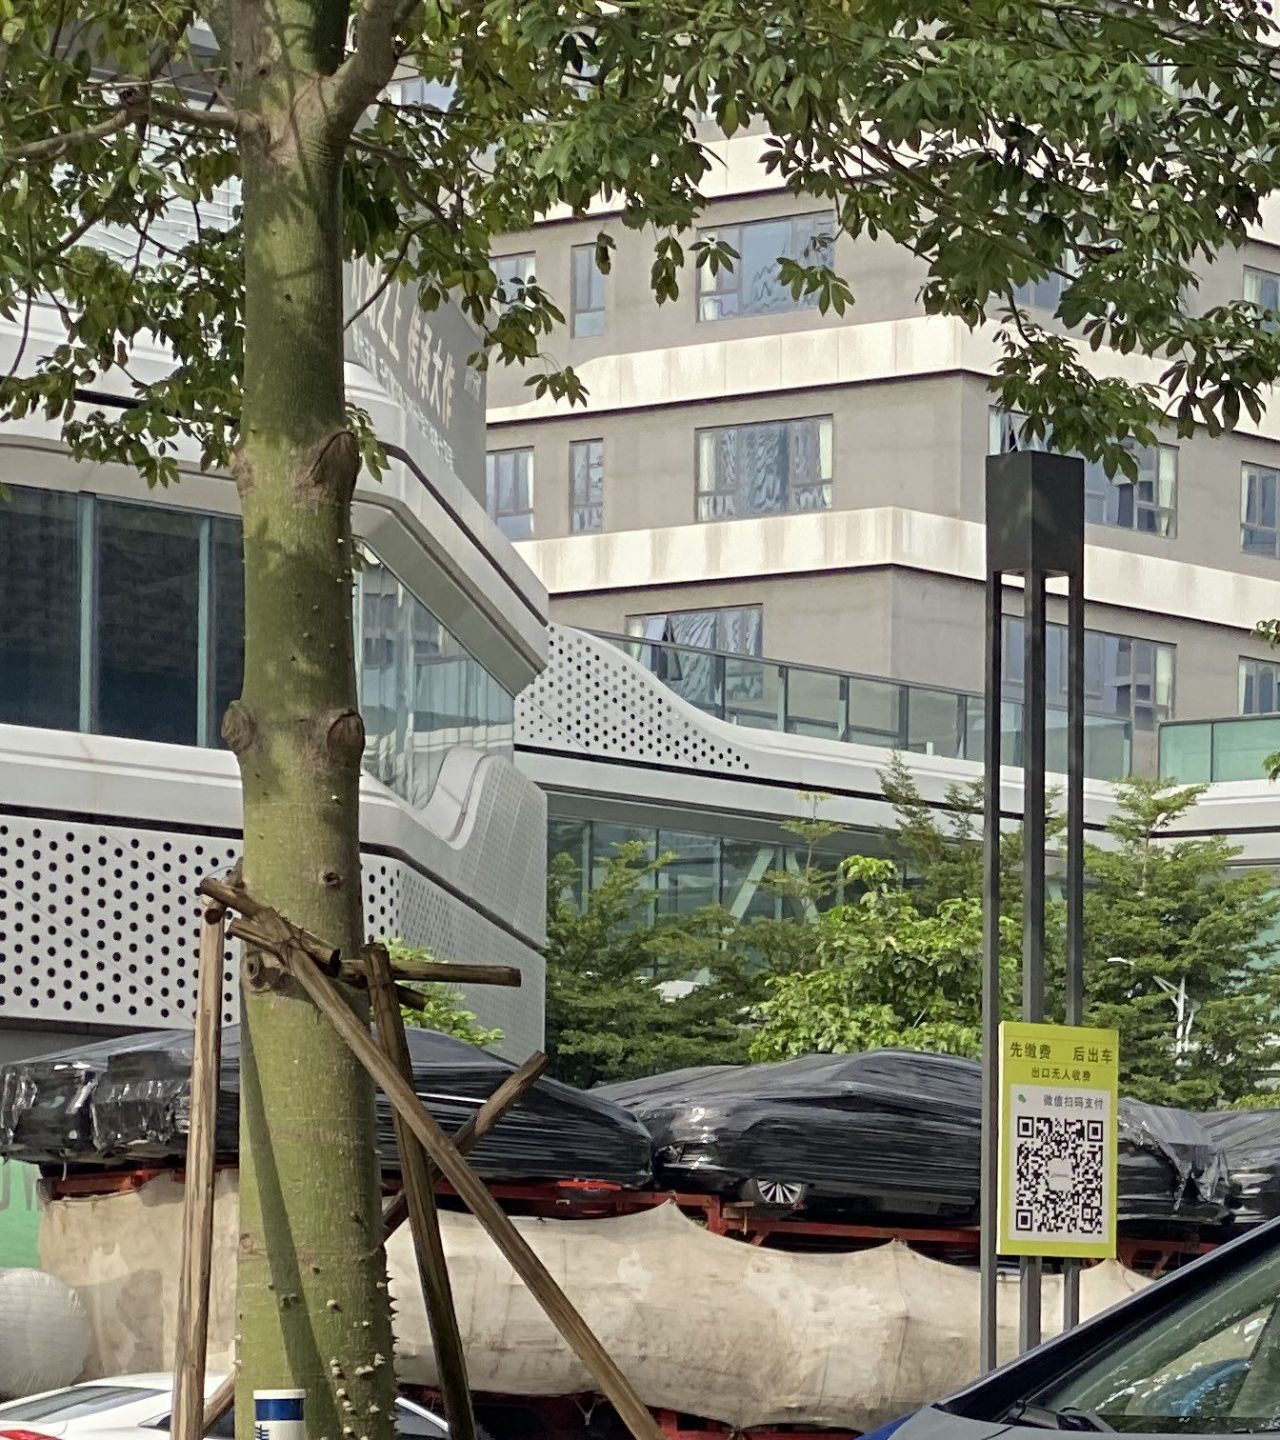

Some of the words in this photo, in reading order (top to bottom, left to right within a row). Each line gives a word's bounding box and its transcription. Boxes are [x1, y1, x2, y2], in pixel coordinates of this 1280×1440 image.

[1010, 1041, 1051, 1060] 先缴费
[1073, 1046, 1113, 1064] 后出车
[1031, 1067, 1091, 1082] 出口无人收费
[1043, 1095, 1103, 1110] 微信扫码支付
